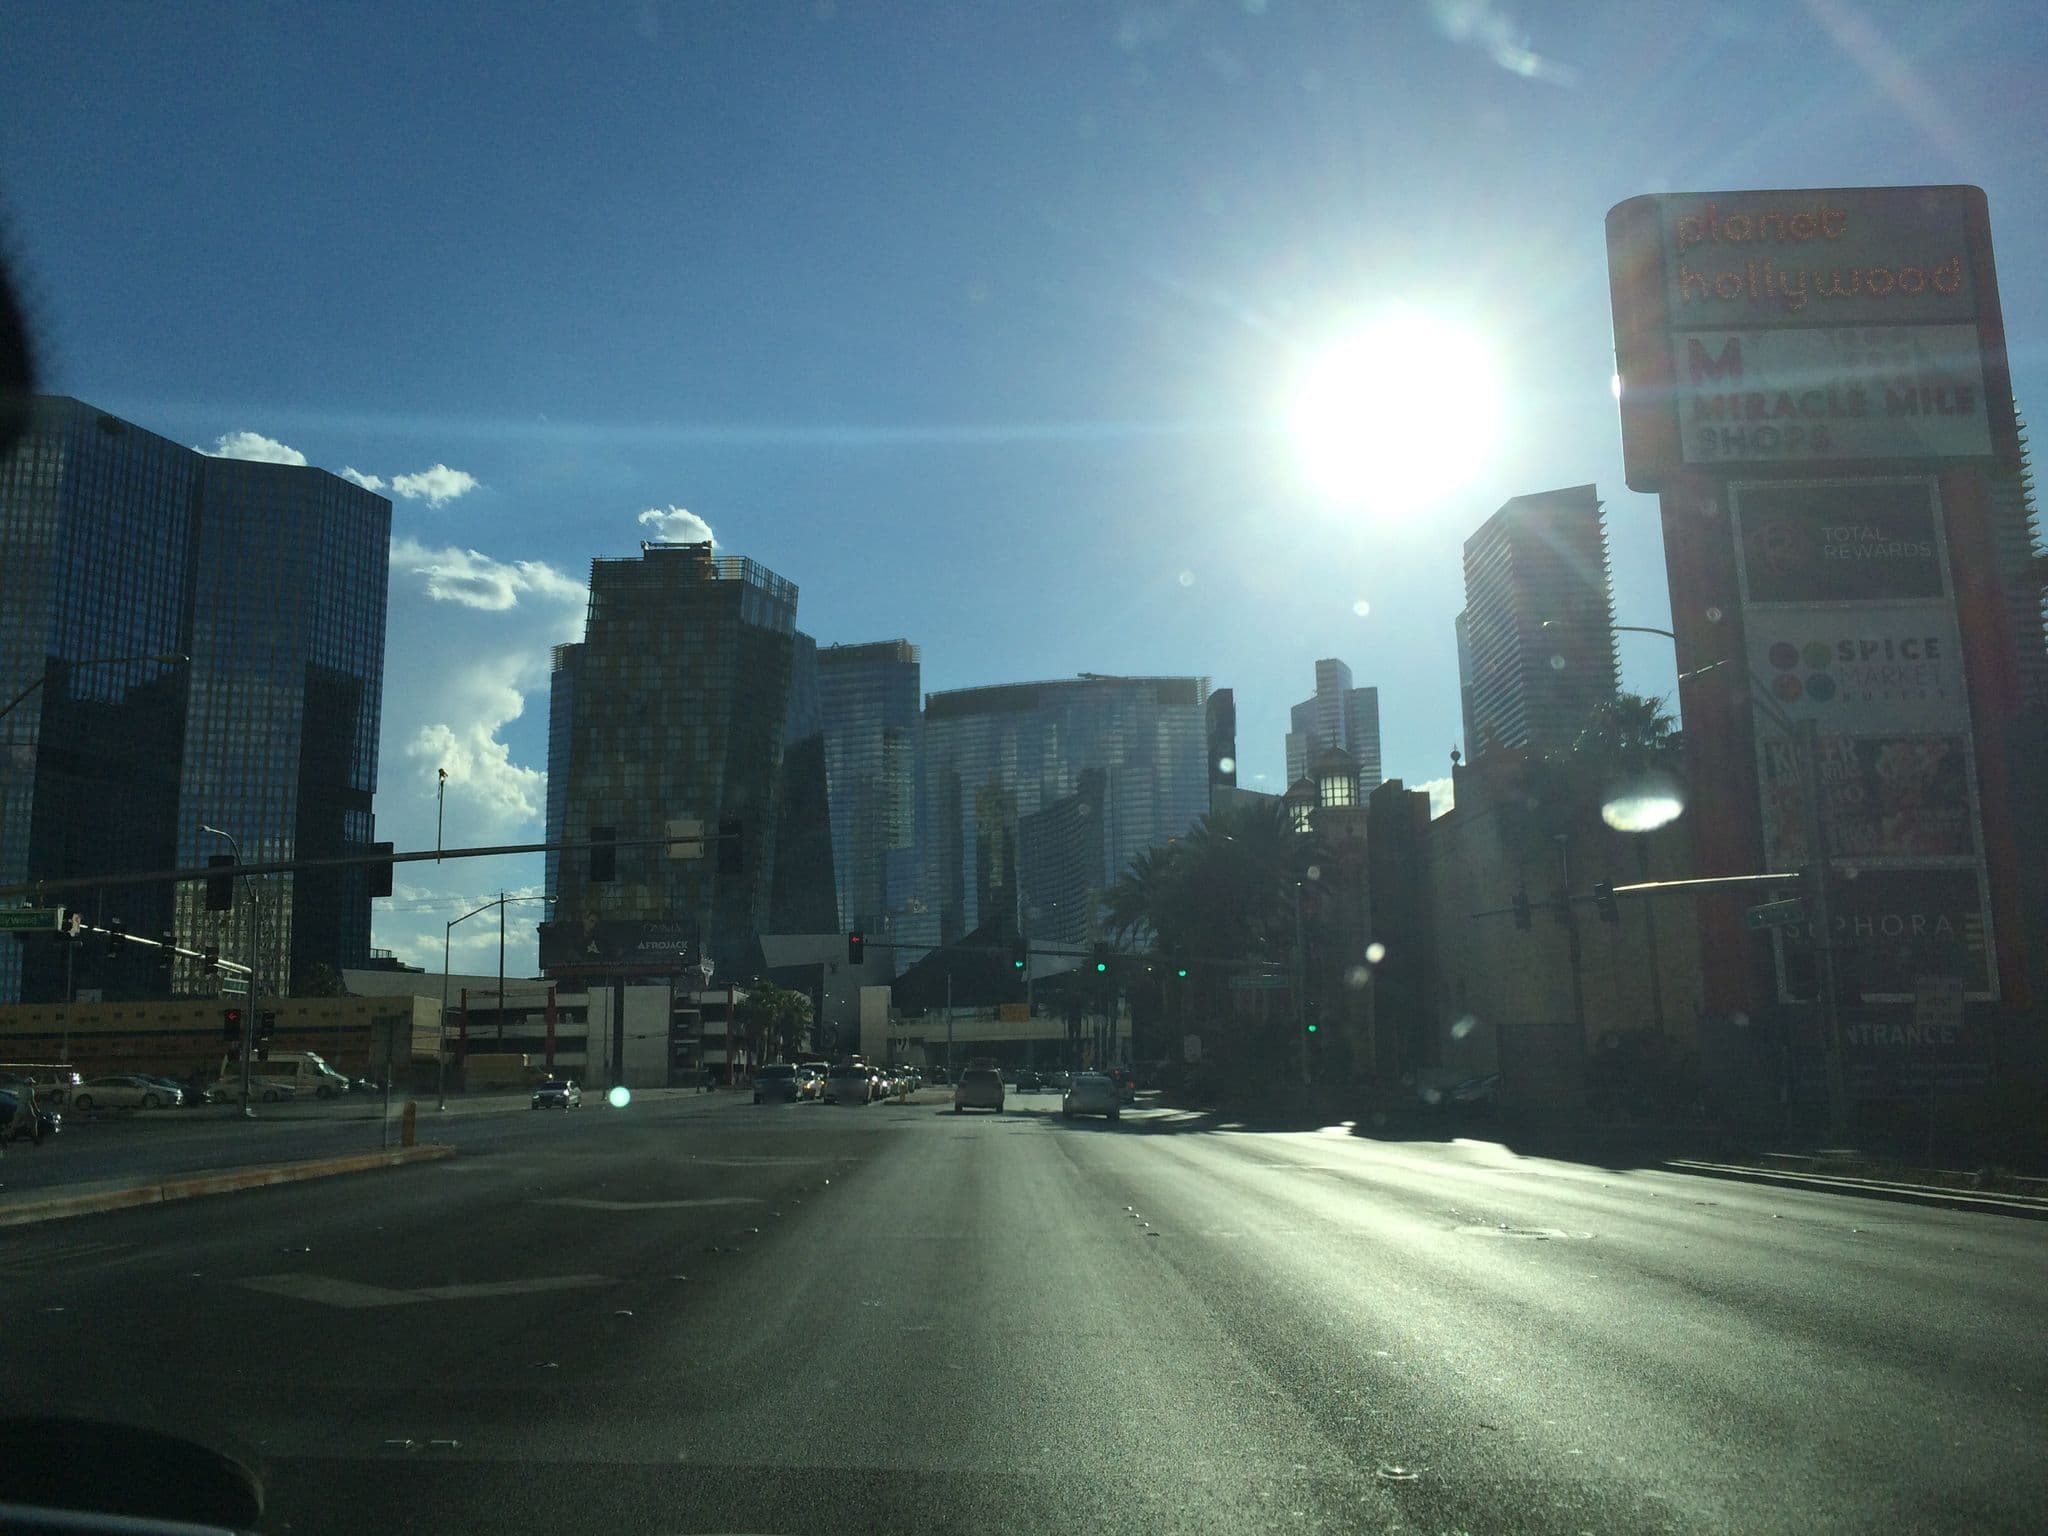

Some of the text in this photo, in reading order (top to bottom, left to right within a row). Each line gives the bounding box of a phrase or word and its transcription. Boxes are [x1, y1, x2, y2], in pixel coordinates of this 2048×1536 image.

[1679, 203, 1847, 256] planet
[1681, 256, 1961, 311] hollywood
[1692, 385, 1977, 419] MIRACLE MILE
[1698, 424, 1832, 455] SHOPS
[1821, 525, 1889, 542] TOTAL
[1823, 541, 1931, 560] REWARDS
[1837, 637, 1941, 661] SPICE
[637, 940, 689, 950] AFROJACK
[1843, 1023, 1956, 1045] NTRANCE
